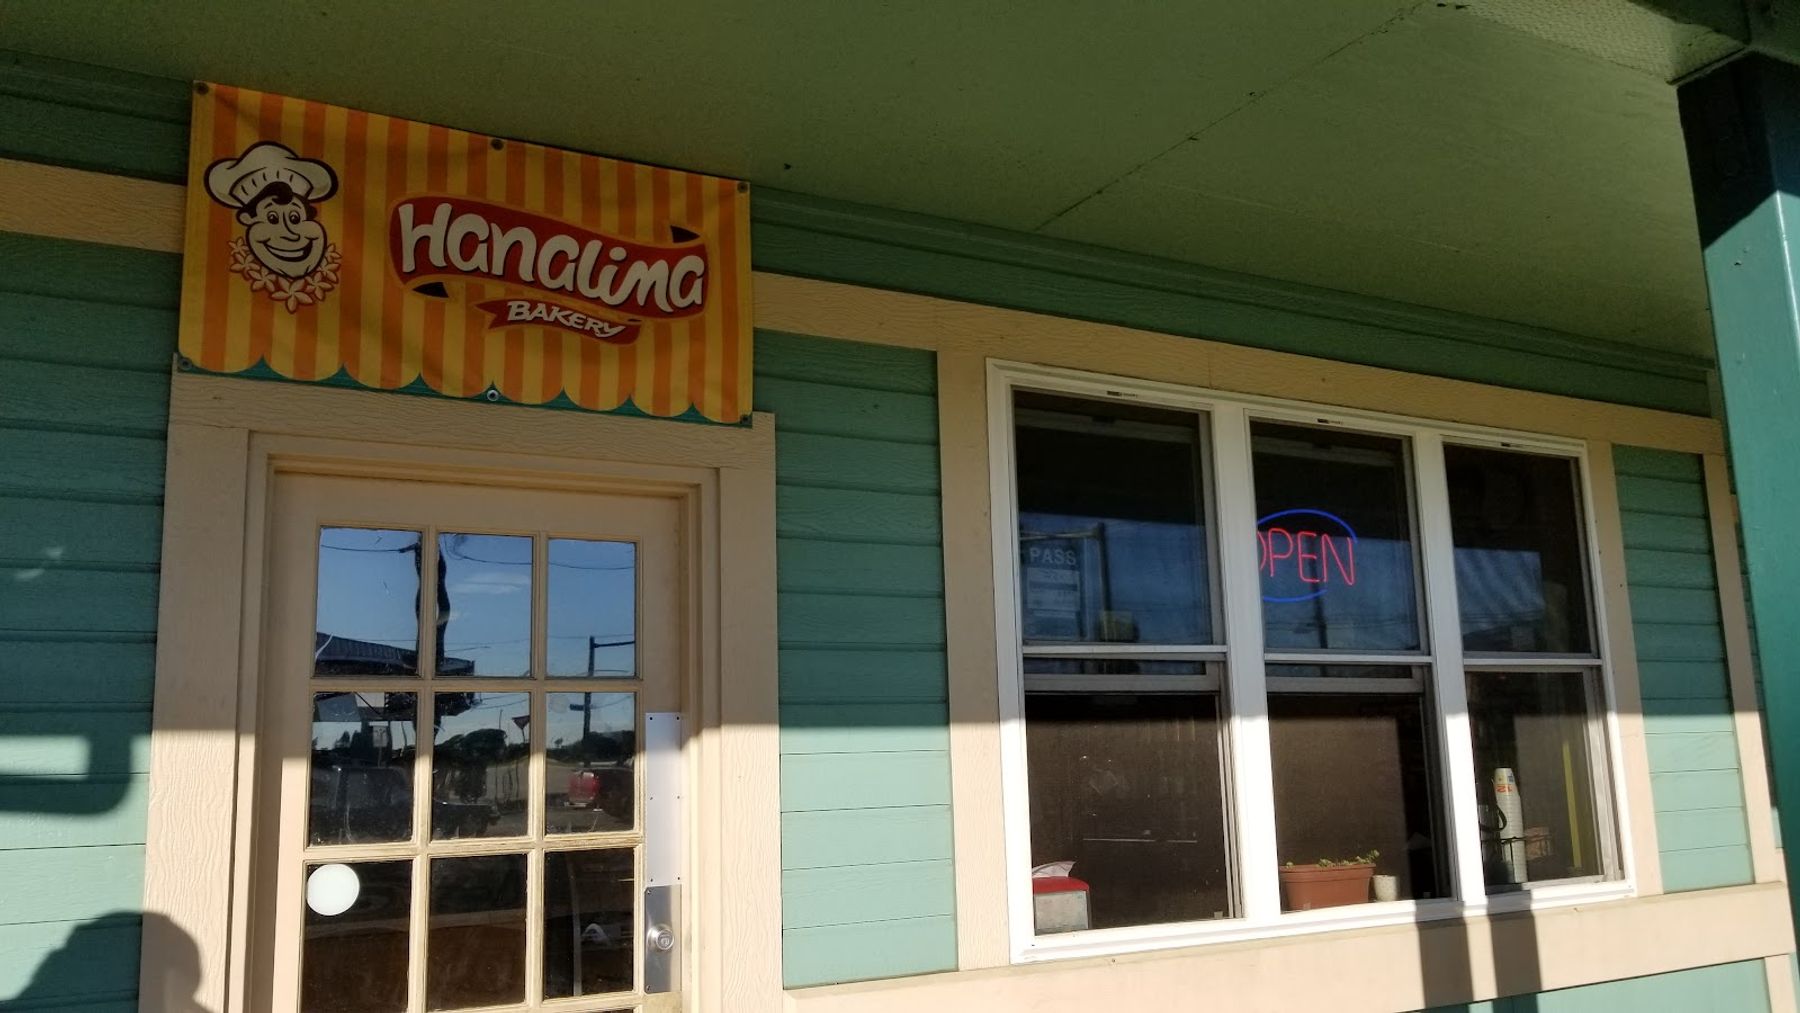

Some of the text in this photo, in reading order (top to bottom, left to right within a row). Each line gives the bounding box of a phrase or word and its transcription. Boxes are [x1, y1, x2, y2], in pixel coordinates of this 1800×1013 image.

[398, 202, 705, 313] Hanalima
[506, 300, 625, 338] BAKERY
[1029, 547, 1077, 566] PASS
